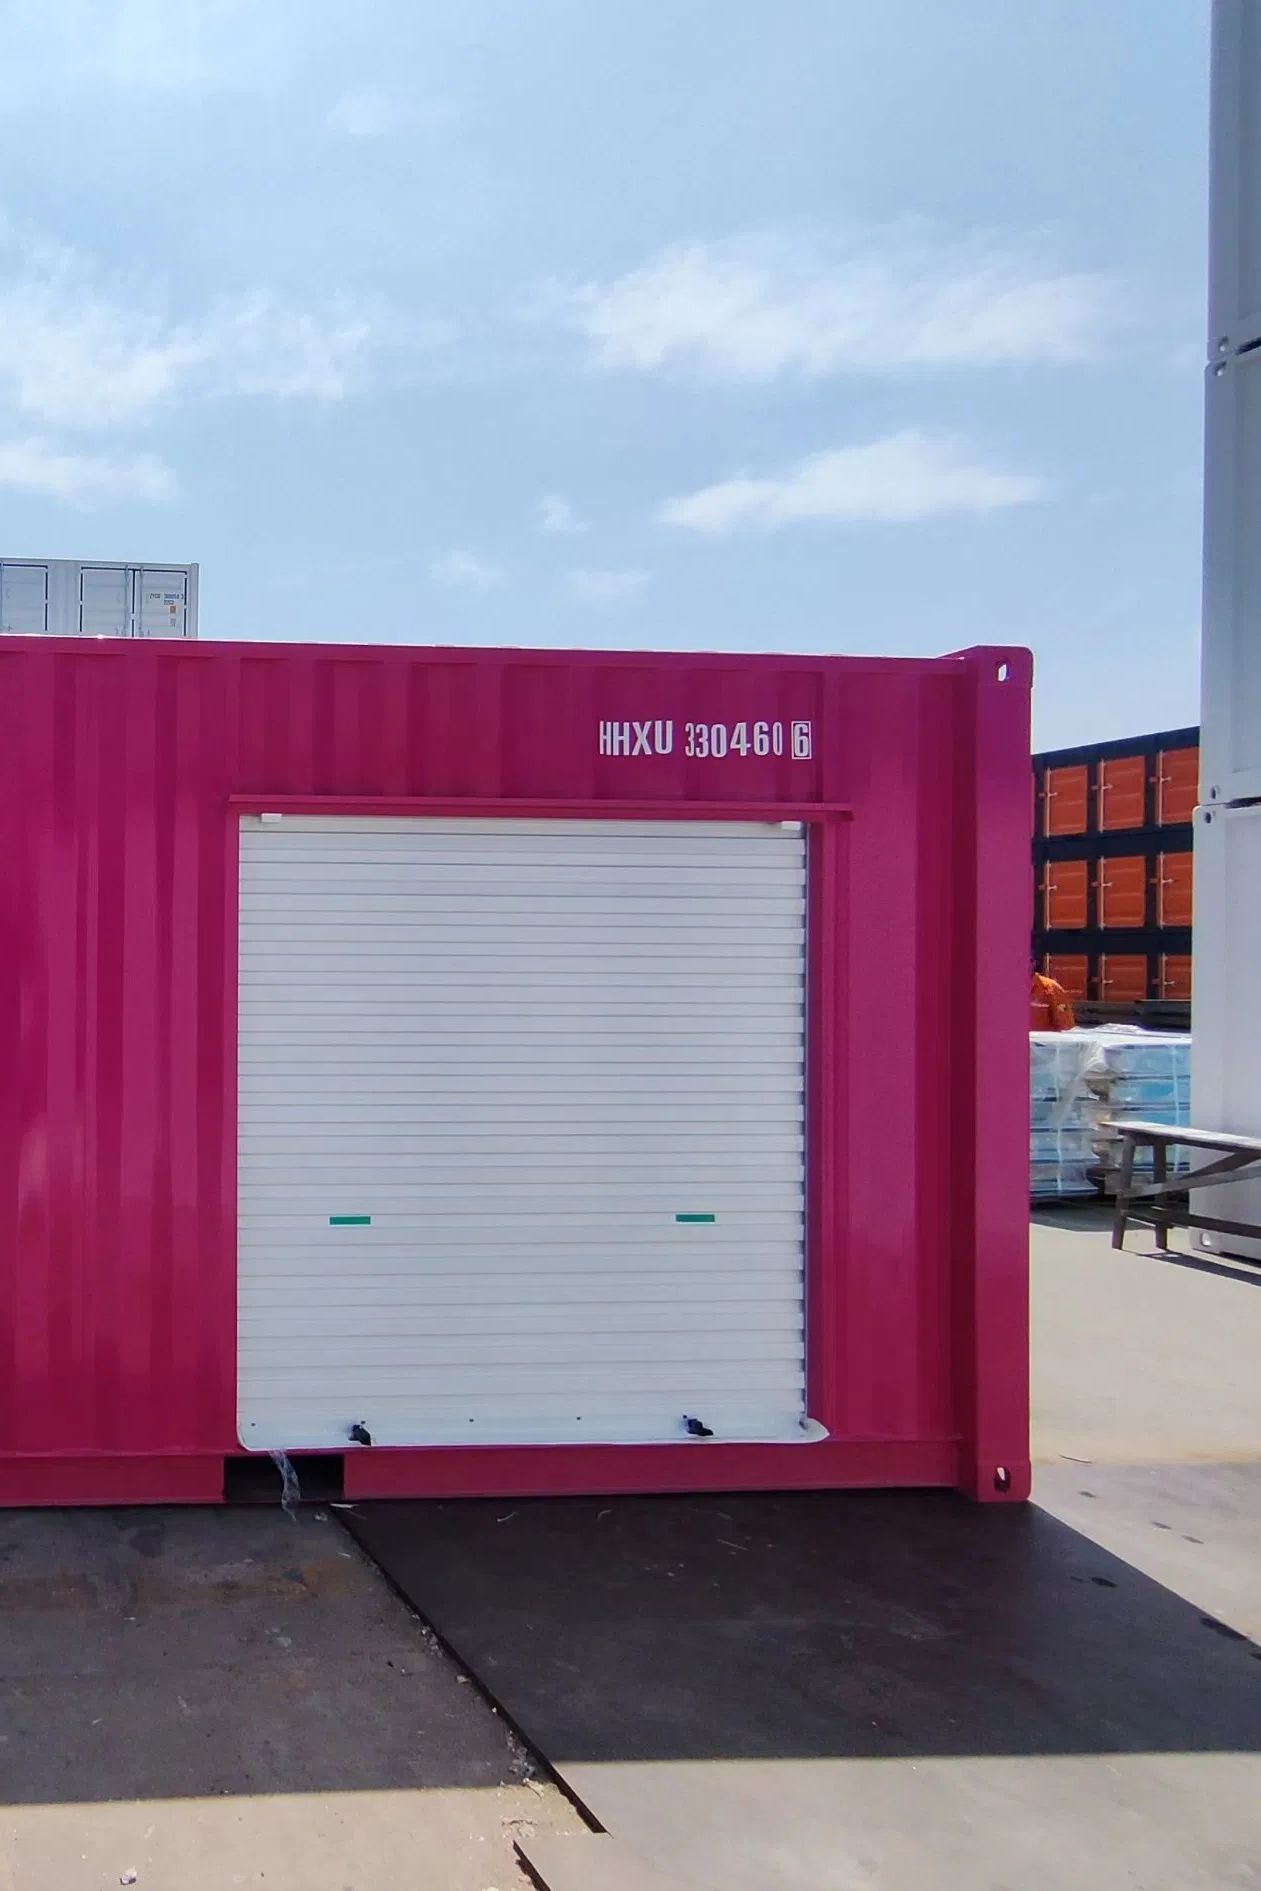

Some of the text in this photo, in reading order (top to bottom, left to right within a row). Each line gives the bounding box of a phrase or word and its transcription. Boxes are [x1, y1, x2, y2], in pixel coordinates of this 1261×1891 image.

[599, 720, 810, 758] HHXU 330460 6
